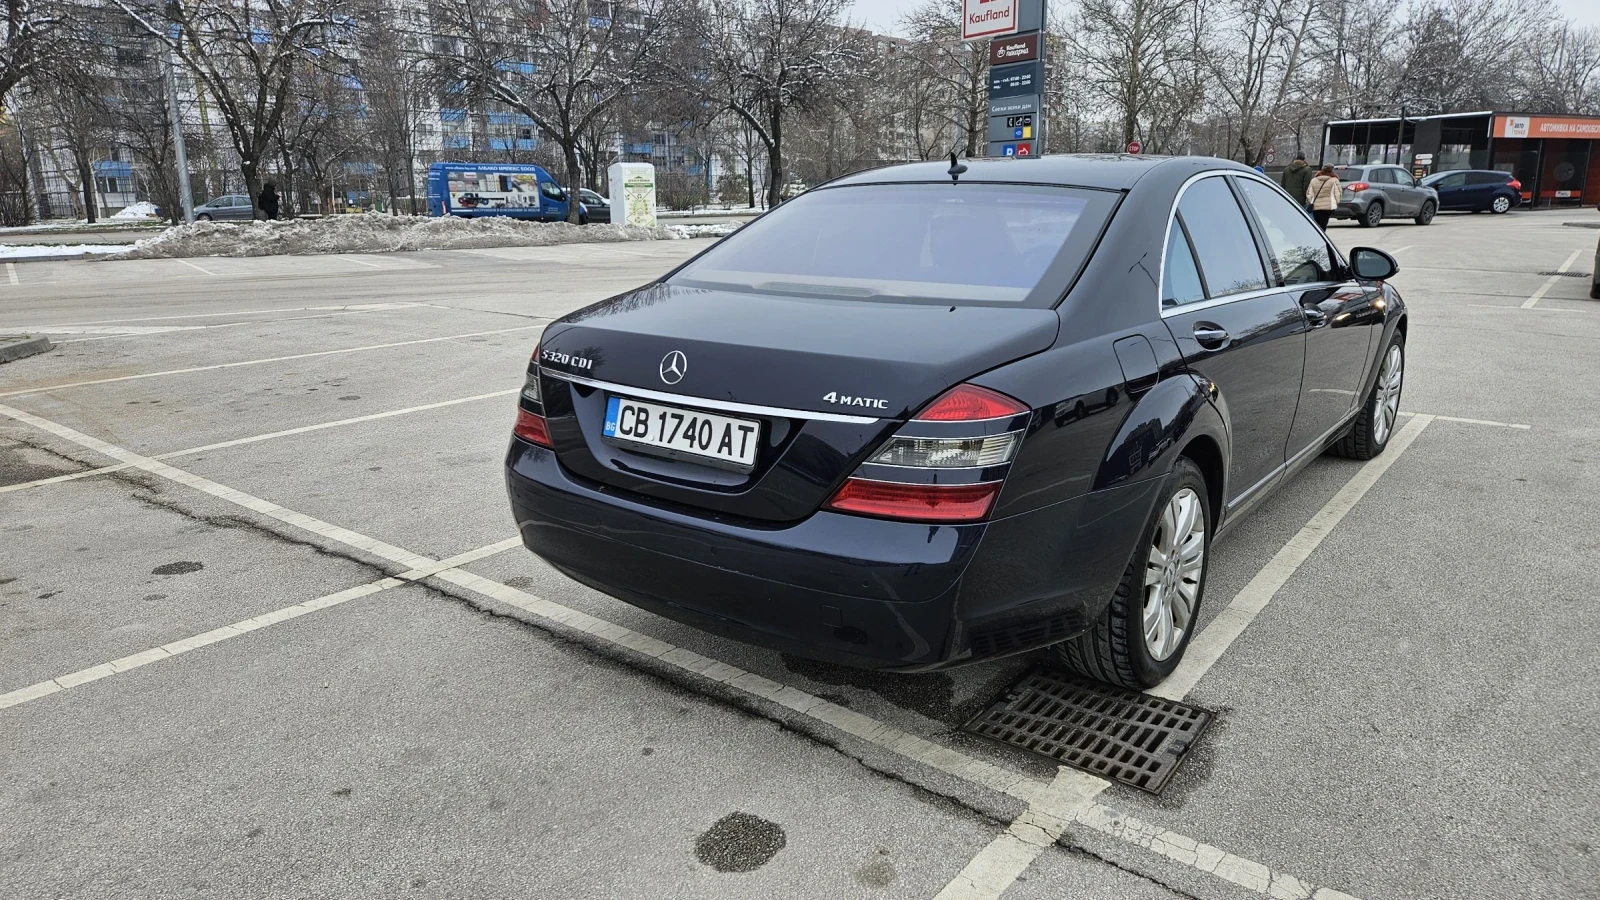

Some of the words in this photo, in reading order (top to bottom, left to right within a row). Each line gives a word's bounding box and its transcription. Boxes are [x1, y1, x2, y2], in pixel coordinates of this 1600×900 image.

[970, 6, 1010, 24] Kaufland
[1569, 124, 1576, 132] НА
[542, 350, 570, 364] S320
[571, 356, 592, 369] CDI
[606, 422, 616, 432] BG
[620, 405, 649, 438] CB
[659, 412, 712, 450] 1740
[717, 422, 754, 458] AT
